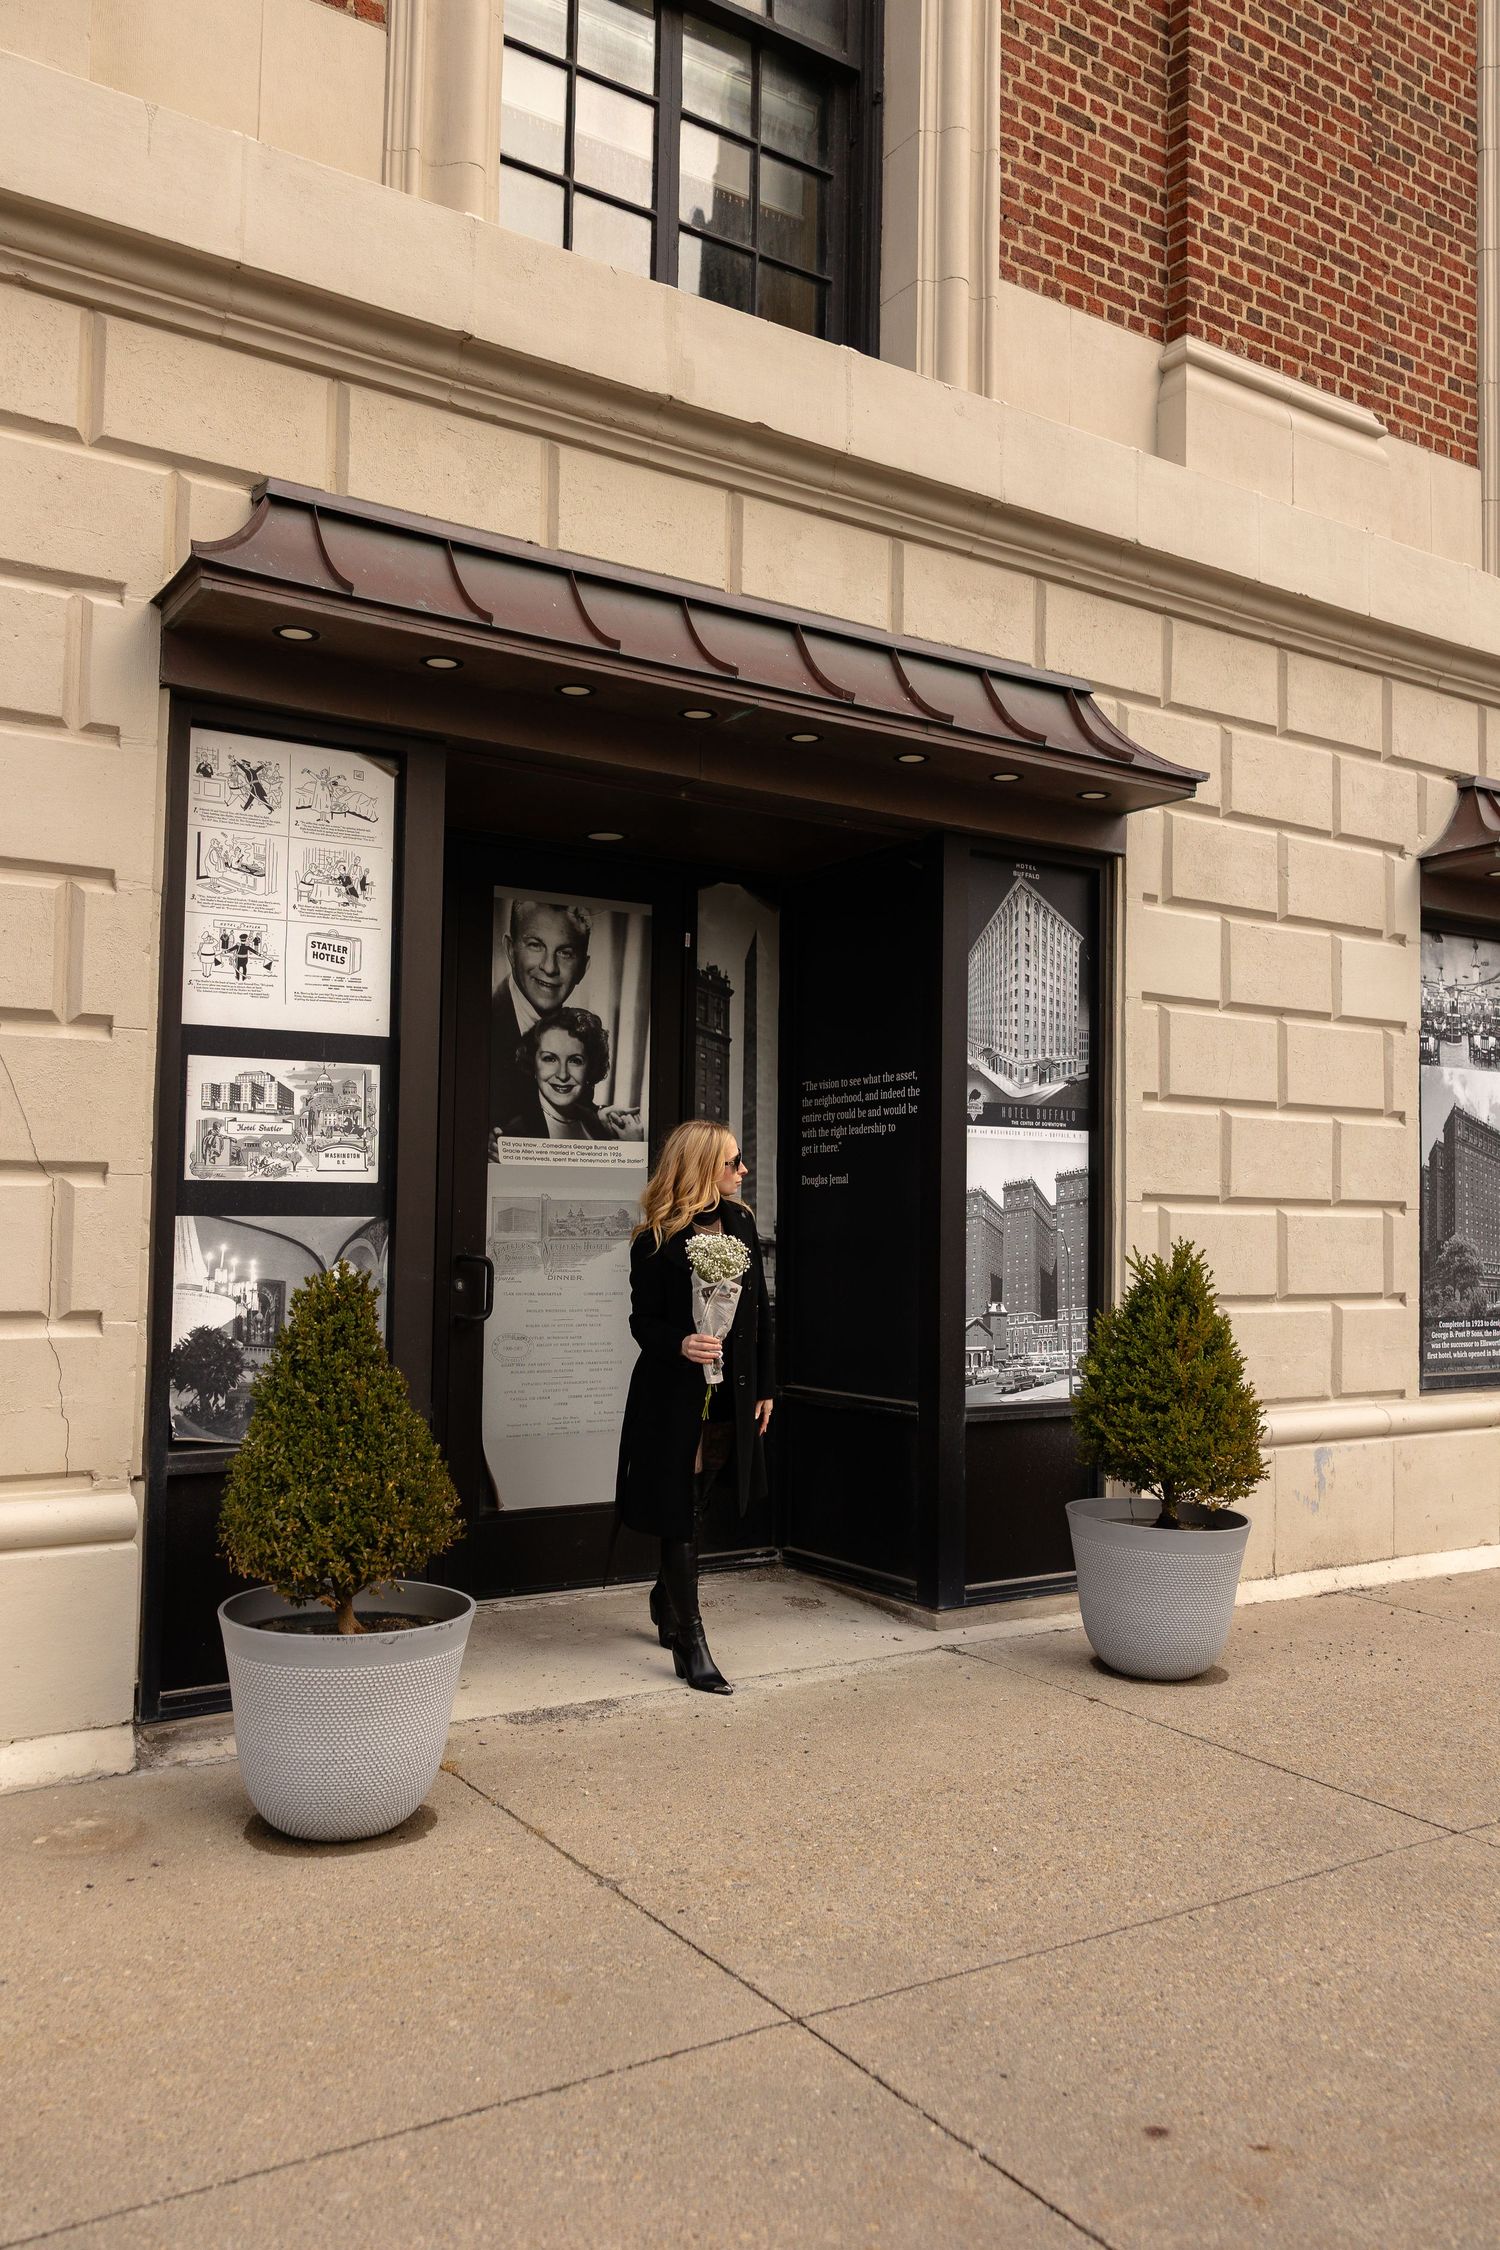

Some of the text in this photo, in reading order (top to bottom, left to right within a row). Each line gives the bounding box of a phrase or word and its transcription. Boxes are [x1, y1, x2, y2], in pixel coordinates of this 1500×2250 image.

[1012, 870, 1040, 880] BUFFALO
[310, 940, 348, 954] STATLER
[312, 951, 346, 964] HOTELS
[819, 1078, 840, 1090] vision
[840, 1079, 848, 1088] to
[849, 1078, 862, 1086] see
[862, 1074, 880, 1084] what
[882, 1072, 894, 1082] the
[896, 1070, 918, 1081] asset,
[802, 1086, 920, 1108] the neighborhood, and indeed the
[802, 1102, 918, 1124] entire city could be and would be
[1001, 1106, 1076, 1122] HOTEL BUFFALO
[236, 1123, 256, 1132] Hotel
[802, 1122, 896, 1139] with the right leadership to
[802, 1145, 812, 1157] get
[814, 1144, 819, 1154] it
[802, 1173, 848, 1188] Douglas Jemal
[1438, 1320, 1464, 1330] Completed
[1472, 1320, 1484, 1328] 1923
[1432, 1332, 1448, 1340] George
[1455, 1330, 1466, 1338] Post
[1427, 1352, 1438, 1360] first
[1438, 1351, 1452, 1360] hotel,
[1468, 1350, 1486, 1359] opened
[1486, 1349, 1492, 1357] in
